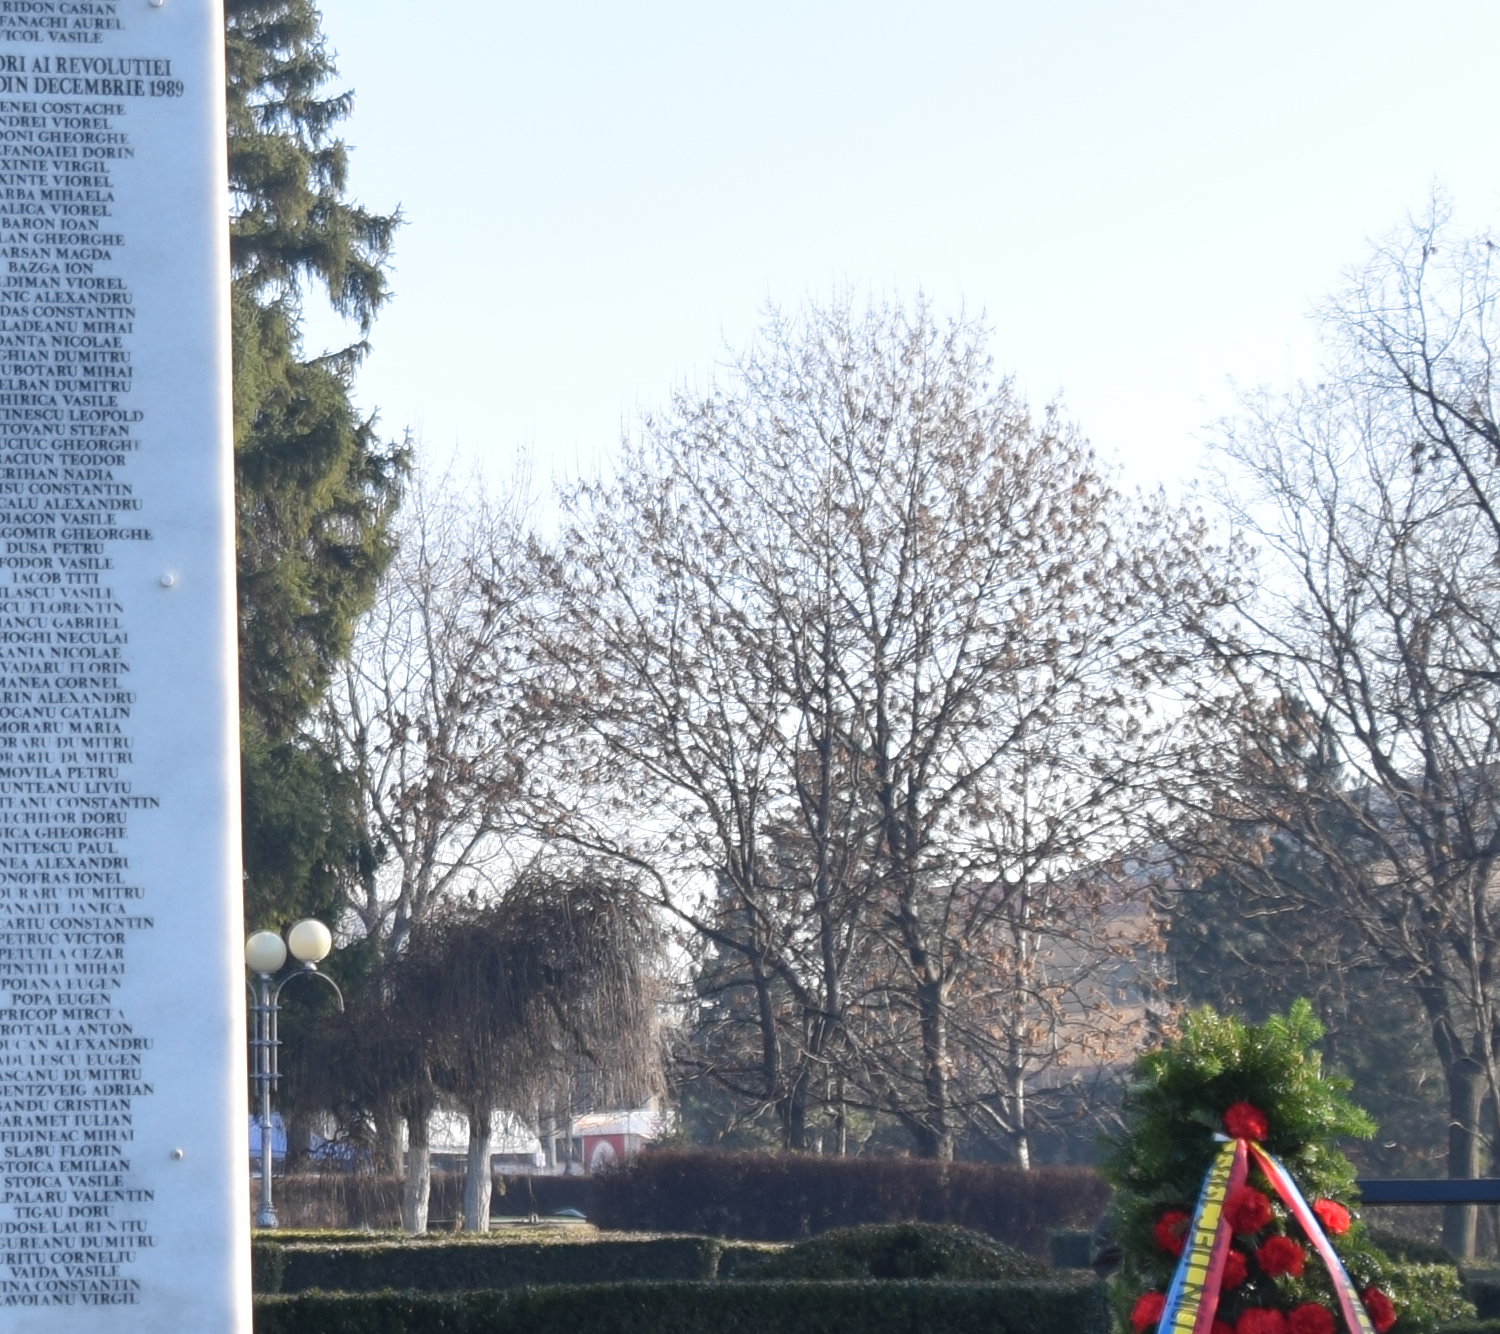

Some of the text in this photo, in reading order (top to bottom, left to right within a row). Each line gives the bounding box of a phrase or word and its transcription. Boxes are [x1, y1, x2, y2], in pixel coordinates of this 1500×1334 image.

[32, 57, 49, 74] AI
[56, 58, 171, 76] REVOLUTIEI
[34, 78, 144, 96] DECEMBRIE
[150, 81, 184, 97] 1989
[42, 103, 125, 115] COSTACHE
[49, 118, 112, 129] VIOREL
[53, 176, 113, 187] VIOREL
[41, 190, 114, 201] MIHAELA
[51, 205, 111, 216] VIOREL
[2, 218, 99, 229] BARON IOAN
[33, 233, 124, 245] GHEORGHE
[56, 249, 111, 260] MAGDA
[9, 262, 93, 274] BAZGA ION
[67, 278, 127, 289] VIOREL
[54, 351, 130, 362] DUMITRU
[63, 395, 117, 407] VASILE
[70, 425, 129, 436] STEFAN
[64, 469, 113, 480] NADIA
[62, 514, 116, 525] VASILE
[7, 543, 104, 554] DUSA PETRU
[60, 558, 113, 569] VASILE
[55, 678, 121, 688] CORNEL
[61, 708, 130, 718] CATALIN
[70, 723, 121, 733] MARIA
[68, 767, 119, 778] PETRU
[85, 783, 131, 793] LIVIU
[2, 842, 117, 853] NITESCU PAUL
[65, 933, 125, 943] VICTOR
[12, 994, 111, 1005] POPA EUGEN
[54, 1100, 130, 1110] CRISTIAN
[4, 1145, 121, 1157] SLABU FLORIN
[60, 1160, 130, 1172] EMILIAN
[11, 1266, 120, 1278] VAIDA VASILE
[82, 1293, 139, 1305] VIRGIL
